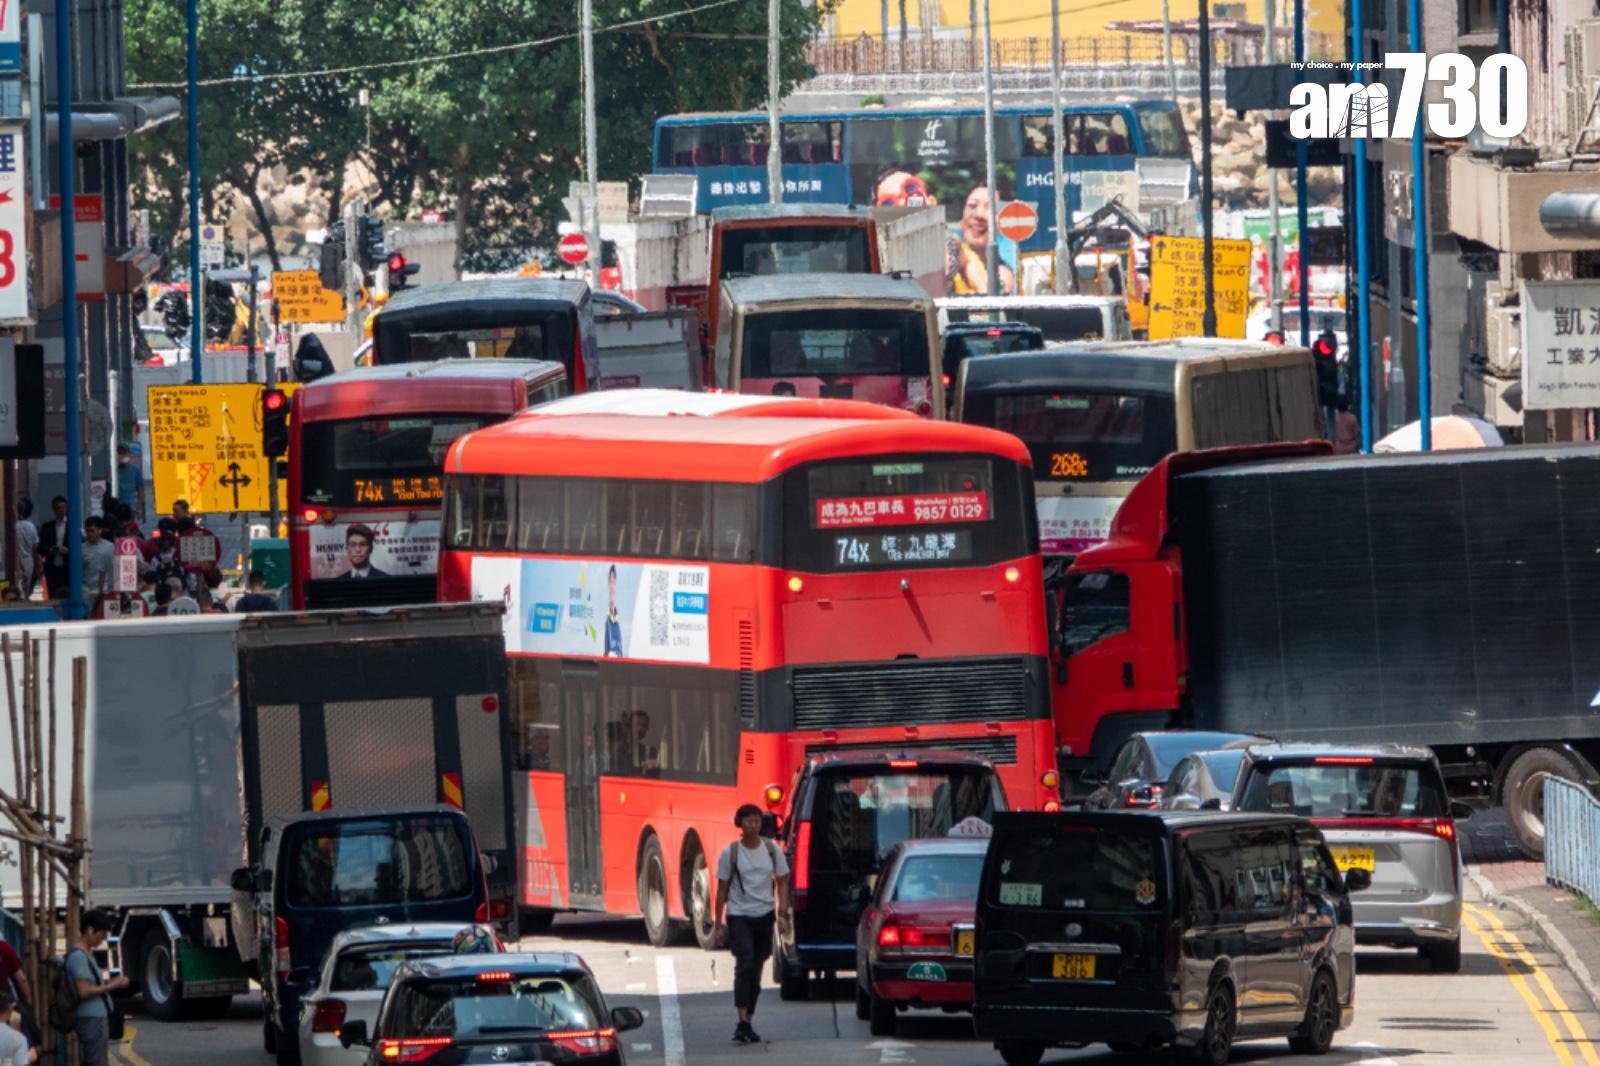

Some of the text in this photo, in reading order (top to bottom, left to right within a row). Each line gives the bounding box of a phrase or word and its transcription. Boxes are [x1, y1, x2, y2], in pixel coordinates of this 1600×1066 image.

[821, 500, 905, 518] 成為九巴車長
[914, 504, 982, 520] 9857 0129
[315, 543, 344, 553] HENRY
[960, 826, 991, 835] TAXI
[1340, 853, 1371, 865] 4271
[1061, 966, 1088, 978] 386
